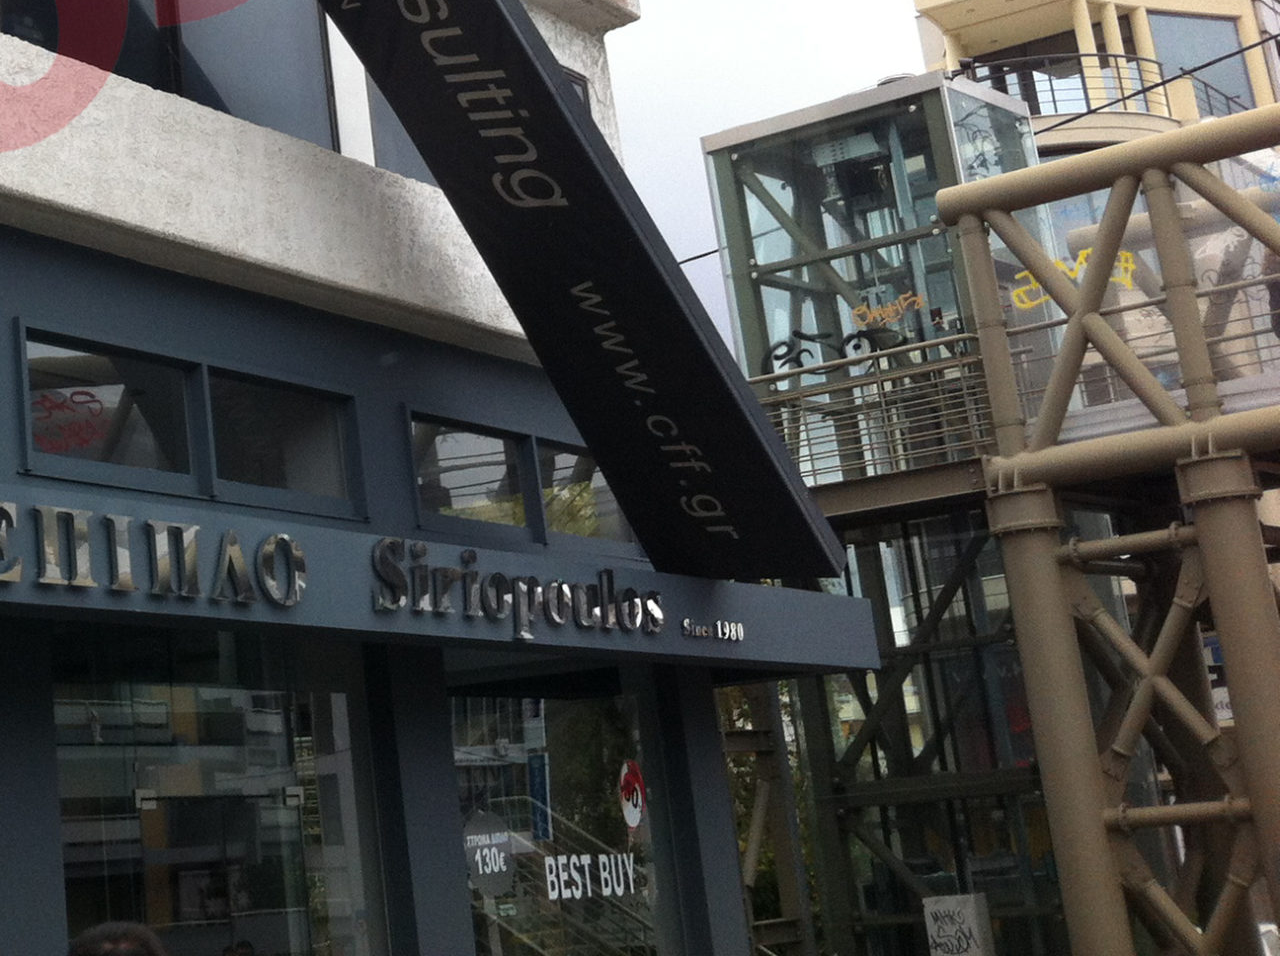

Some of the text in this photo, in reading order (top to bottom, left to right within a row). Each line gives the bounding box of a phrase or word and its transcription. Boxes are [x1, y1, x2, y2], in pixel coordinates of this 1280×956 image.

[570, 279, 740, 540] www.cff.gr
[371, 536, 666, 640] Siriopoulos
[683, 617, 744, 641] Since 1980
[475, 846, 508, 875] 130€
[545, 852, 635, 901] BEST BUY
